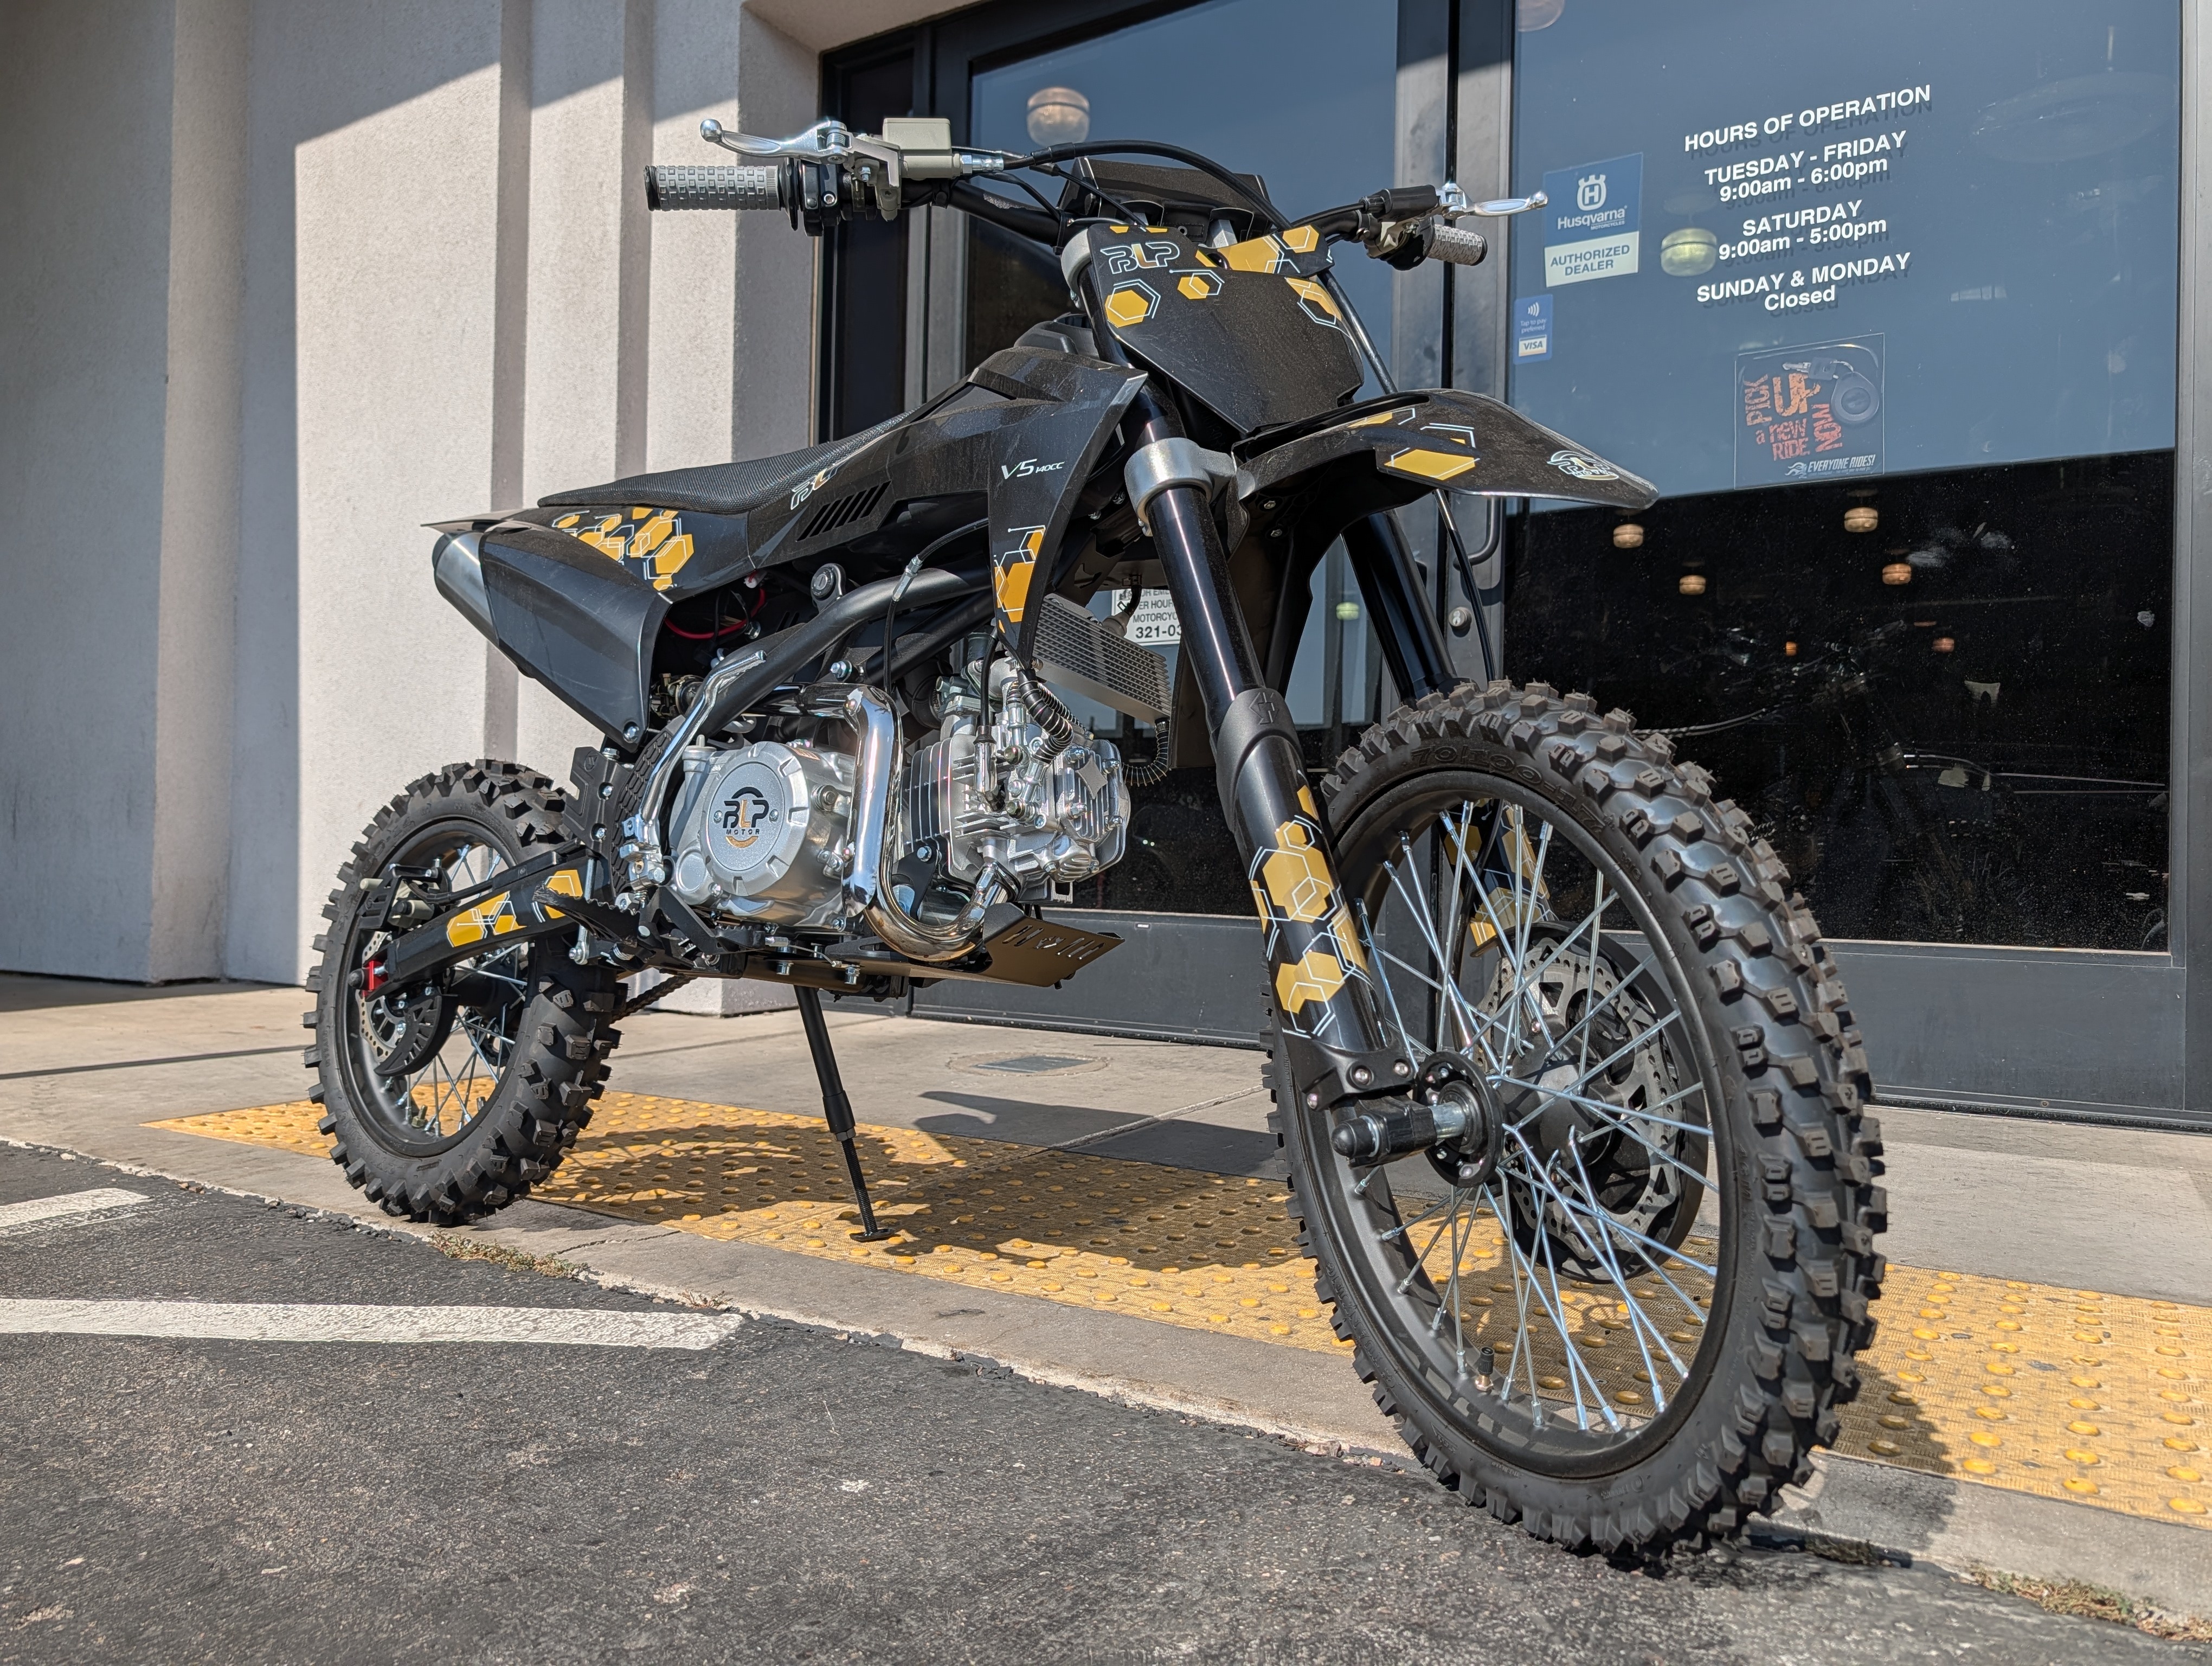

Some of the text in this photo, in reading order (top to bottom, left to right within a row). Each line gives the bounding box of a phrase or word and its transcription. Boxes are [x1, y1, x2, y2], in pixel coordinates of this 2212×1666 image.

[1684, 85, 1931, 152] HOURS OF OPERATION
[1704, 151, 1805, 185] TUESDAY
[1823, 130, 1907, 162] FRIDAY
[1719, 175, 1791, 202] 9:00am
[1810, 158, 1888, 188] 6:00pm
[1557, 207, 1625, 230] Husqvarna
[1742, 200, 1863, 236] SATURDAY
[1718, 235, 1790, 260] 9:00am
[1809, 219, 1887, 244] 5:00pm
[1099, 240, 1180, 274] BLP
[1550, 244, 1630, 267] AUTHORIZED
[1564, 260, 1614, 277] DEALER
[1696, 252, 1911, 303] SUNDAY & MONDAY
[1764, 285, 1836, 311] Closed
[1521, 324, 1546, 334] preferred
[1537, 318, 1547, 326] pay
[1523, 341, 1543, 351] VISA
[1744, 374, 1772, 426] PICK
[1755, 430, 1765, 445] a
[1811, 403, 1843, 453] NOW
[1772, 437, 1810, 462] RIDE
[1001, 458, 1065, 479] V5 140CC
[1807, 457, 1849, 473] EVERYONE
[1849, 454, 1876, 467] RIDES!
[1150, 599, 1173, 609] HOUR
[722, 799, 770, 829] BLP
